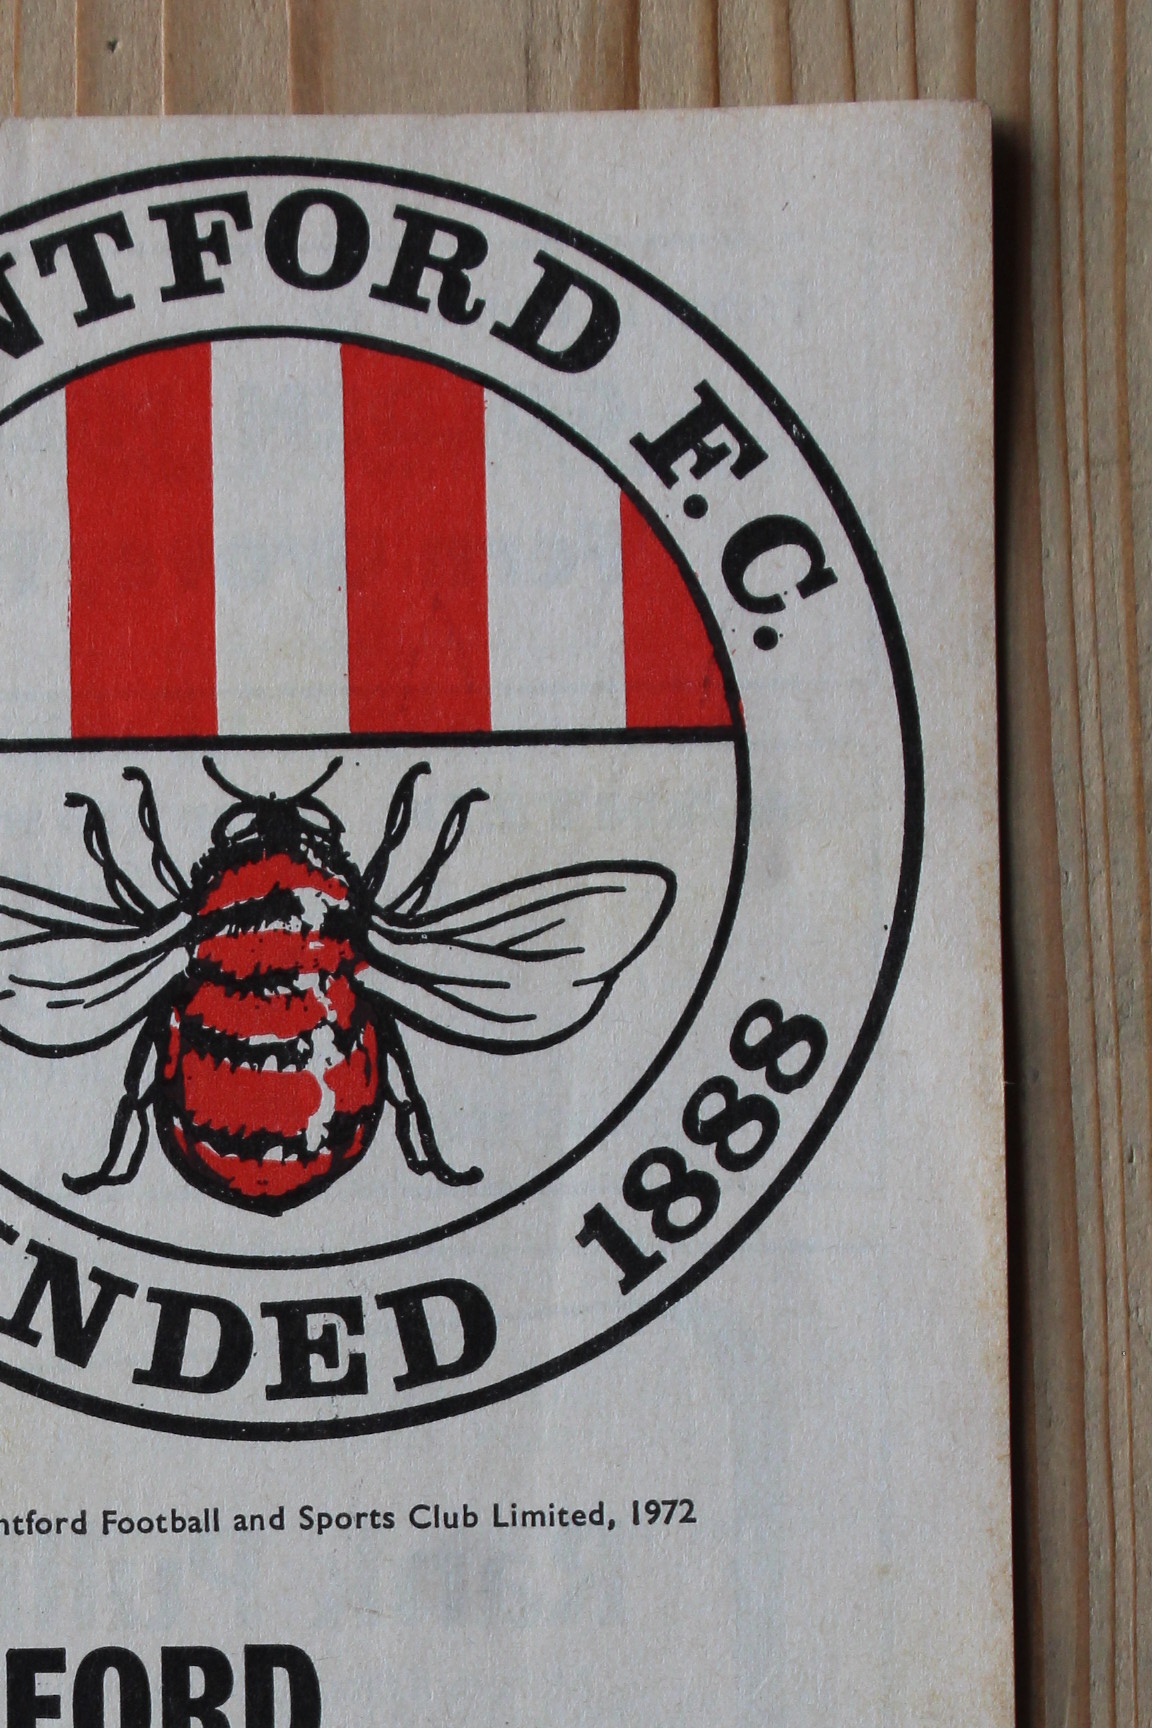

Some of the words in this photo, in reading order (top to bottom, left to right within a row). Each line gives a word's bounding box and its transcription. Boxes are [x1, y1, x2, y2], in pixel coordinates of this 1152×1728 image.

[627, 377, 840, 653] F.C.
[573, 997, 830, 1297] 1888
[101, 1506, 221, 1537] Football
[232, 1504, 286, 1533] and
[298, 1503, 396, 1537] Sports
[407, 1502, 480, 1531] Club
[492, 1499, 617, 1532] Limited,
[631, 1497, 698, 1527] 1972
